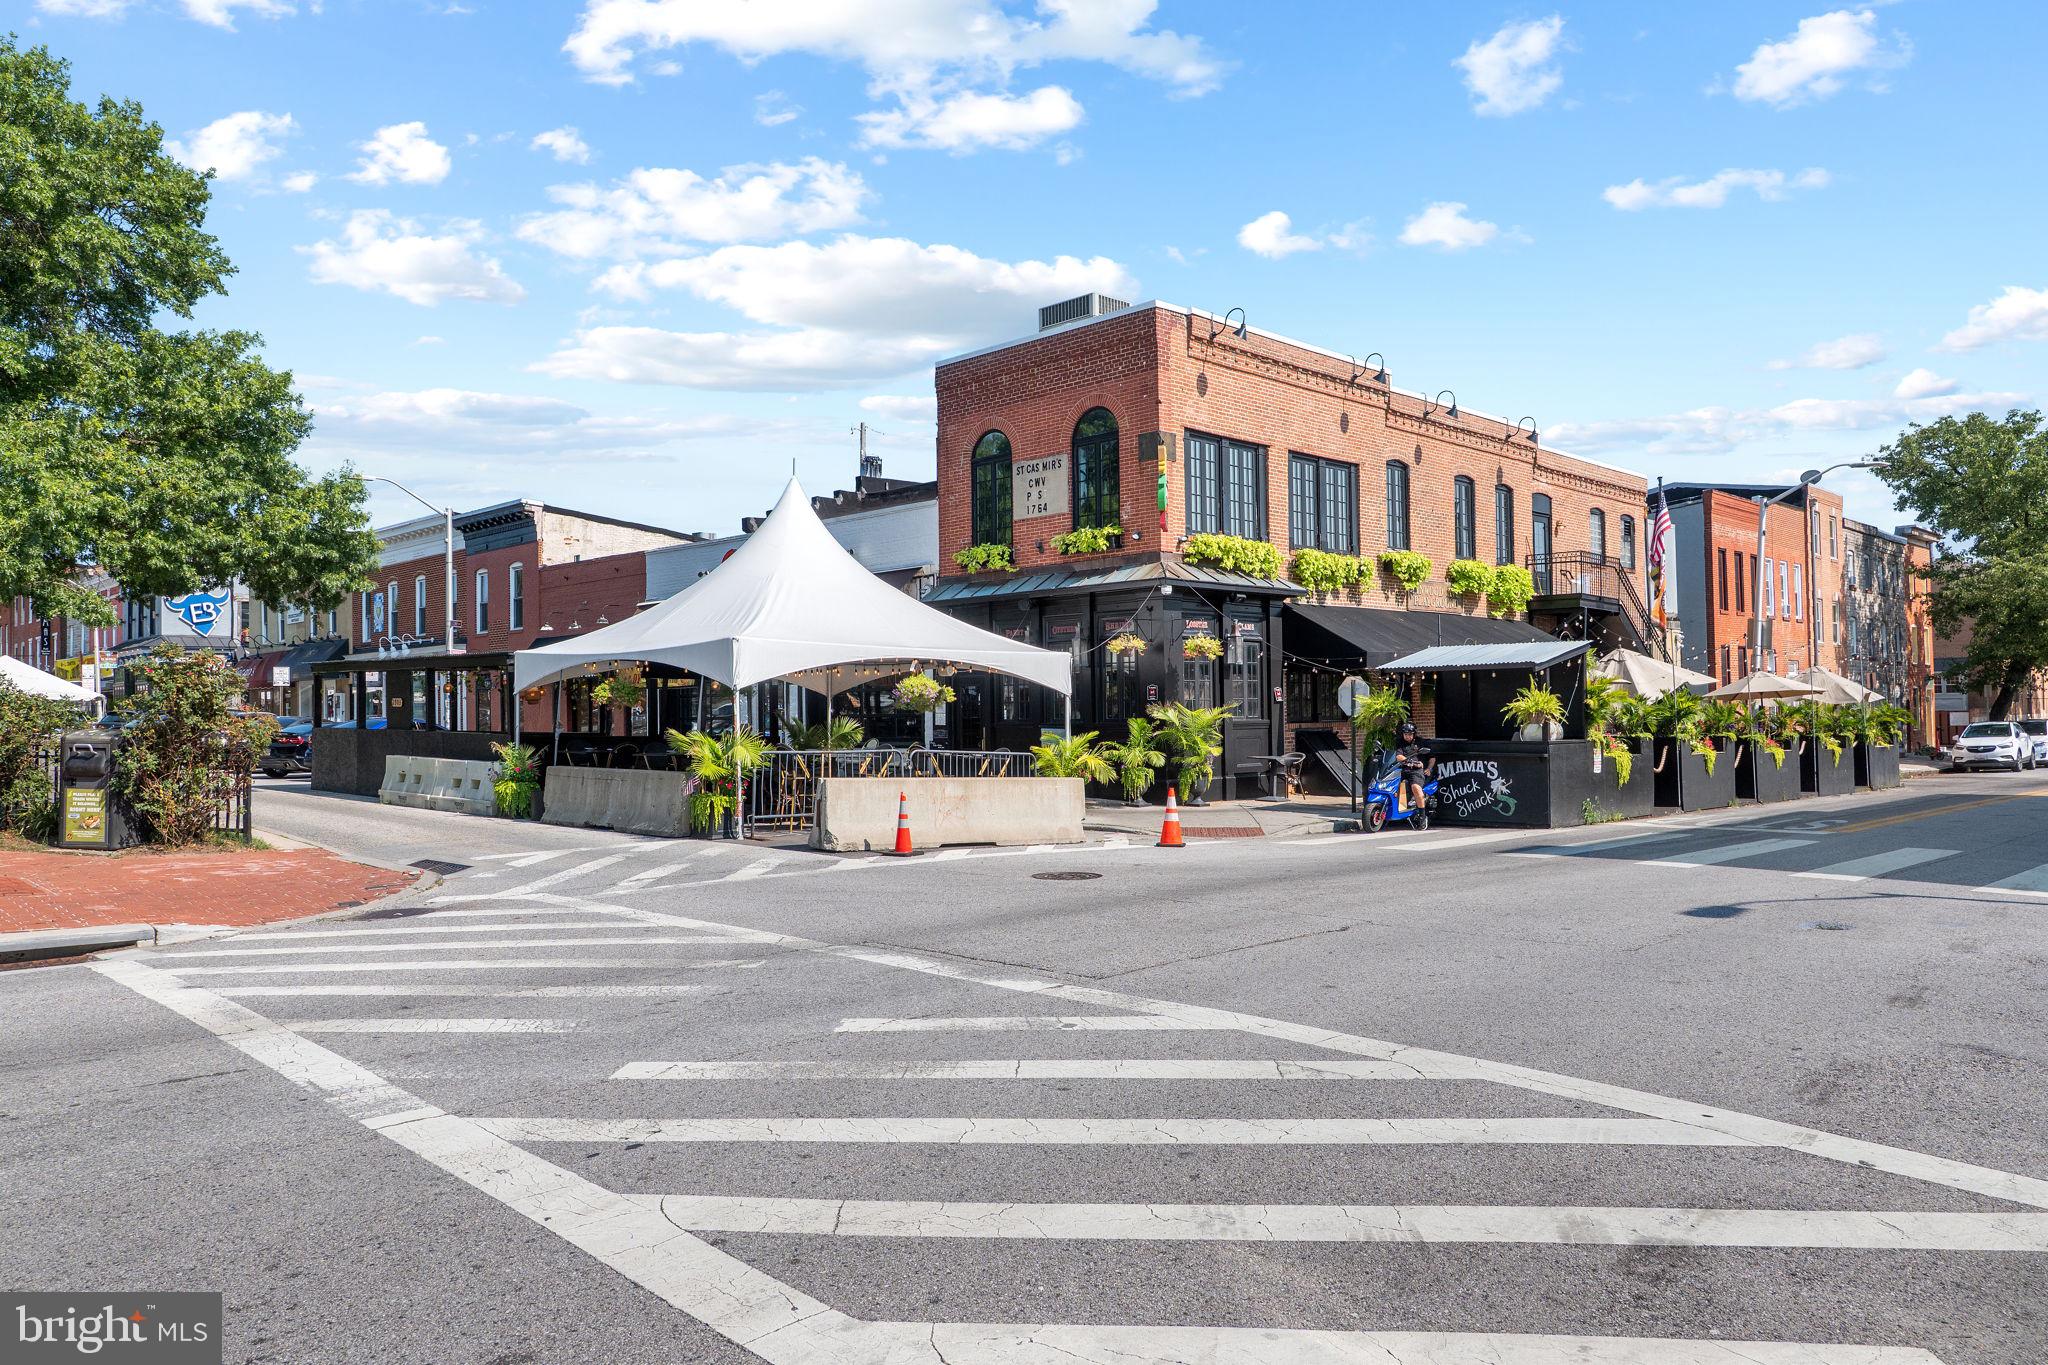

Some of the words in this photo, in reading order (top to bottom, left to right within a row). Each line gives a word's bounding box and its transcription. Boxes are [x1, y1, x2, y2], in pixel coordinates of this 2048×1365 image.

[1016, 465, 1024, 476] ST
[1028, 476, 1046, 488] CWV
[1026, 491, 1032, 501] P
[1037, 490, 1043, 500] S
[1026, 502, 1048, 515] 1764
[190, 602, 217, 623] EB
[1437, 760, 1498, 780] MAMA'S
[1440, 778, 1480, 804] Shuck
[1456, 790, 1495, 817] Shack
